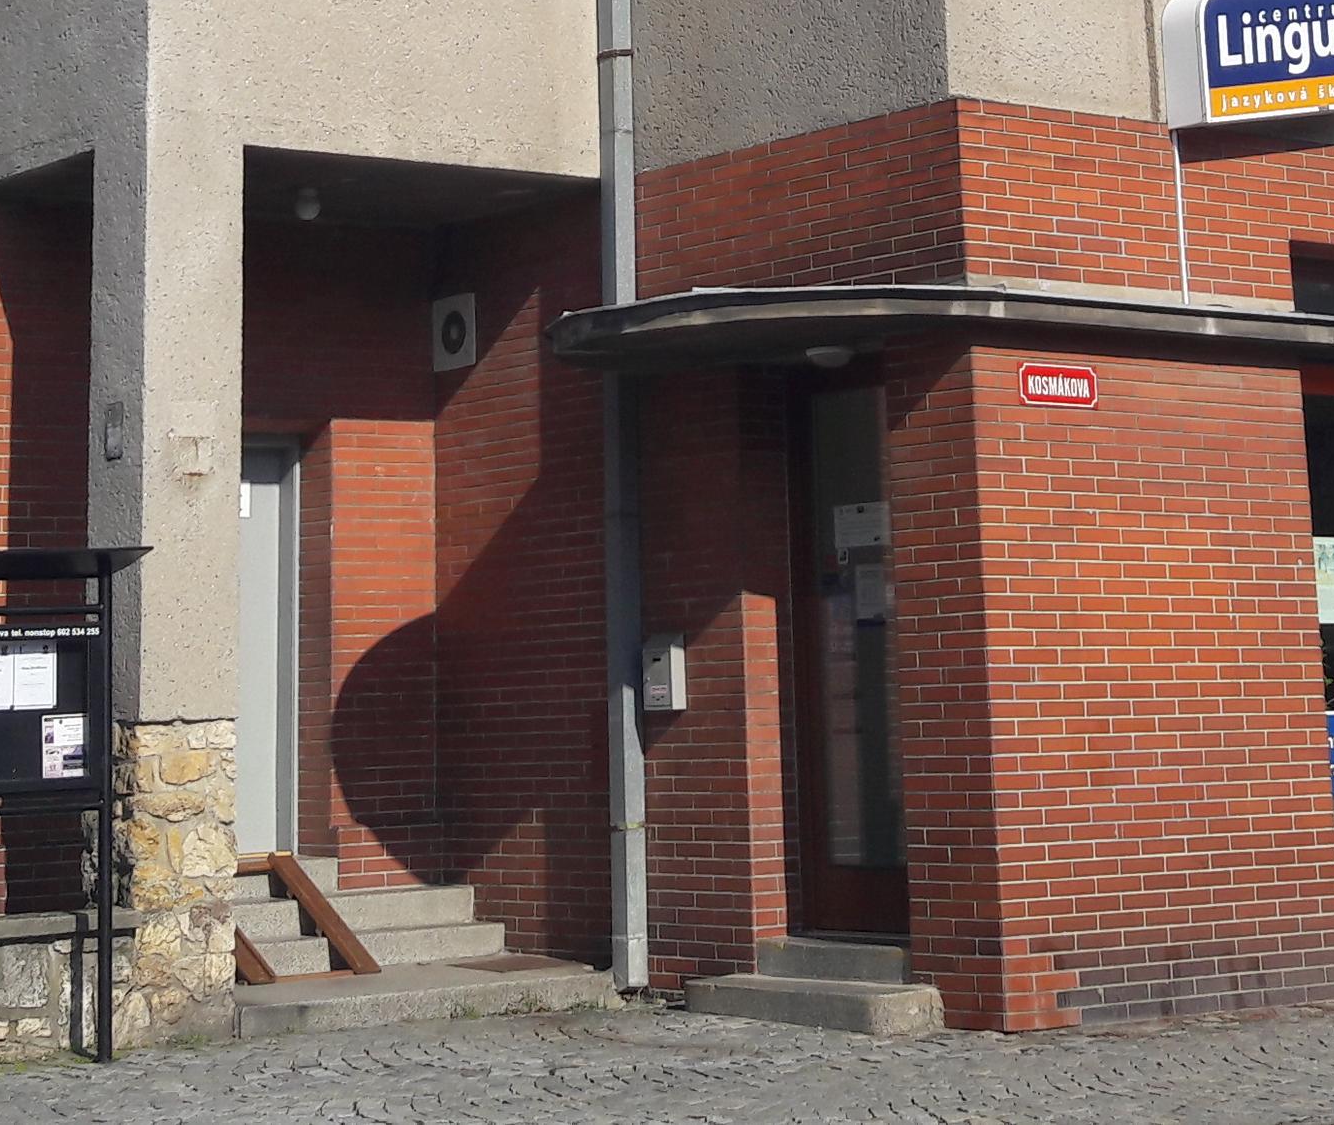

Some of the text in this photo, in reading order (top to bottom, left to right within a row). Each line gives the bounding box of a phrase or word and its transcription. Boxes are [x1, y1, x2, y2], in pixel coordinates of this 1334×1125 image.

[1221, 86, 1308, 113] jazyková
[1028, 373, 1091, 398] KOSMÁKOVA
[11, 628, 23, 636] tel.
[24, 628, 56, 638] nonstop
